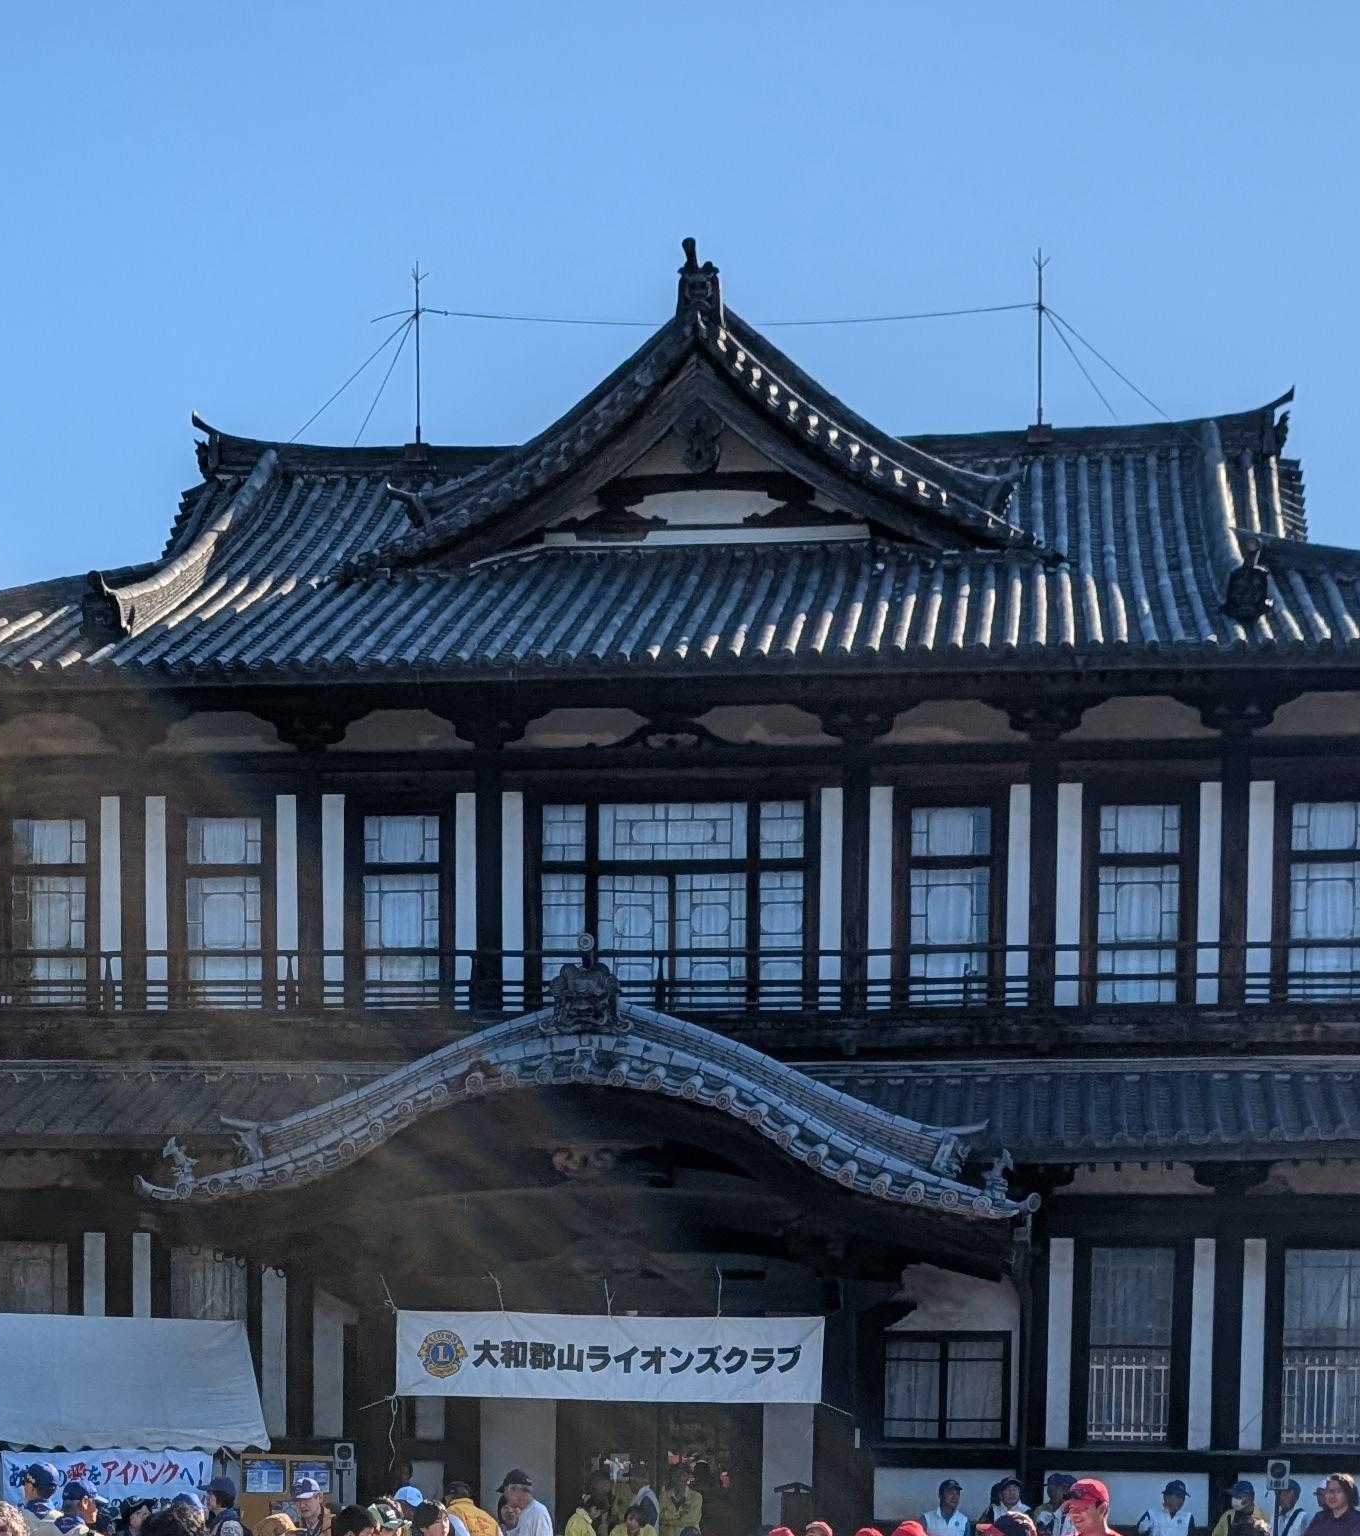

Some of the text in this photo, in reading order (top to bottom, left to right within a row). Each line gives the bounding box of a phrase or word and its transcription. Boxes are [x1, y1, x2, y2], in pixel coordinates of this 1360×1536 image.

[472, 1339, 802, 1375] 大和郡山ライオンズクラブ
